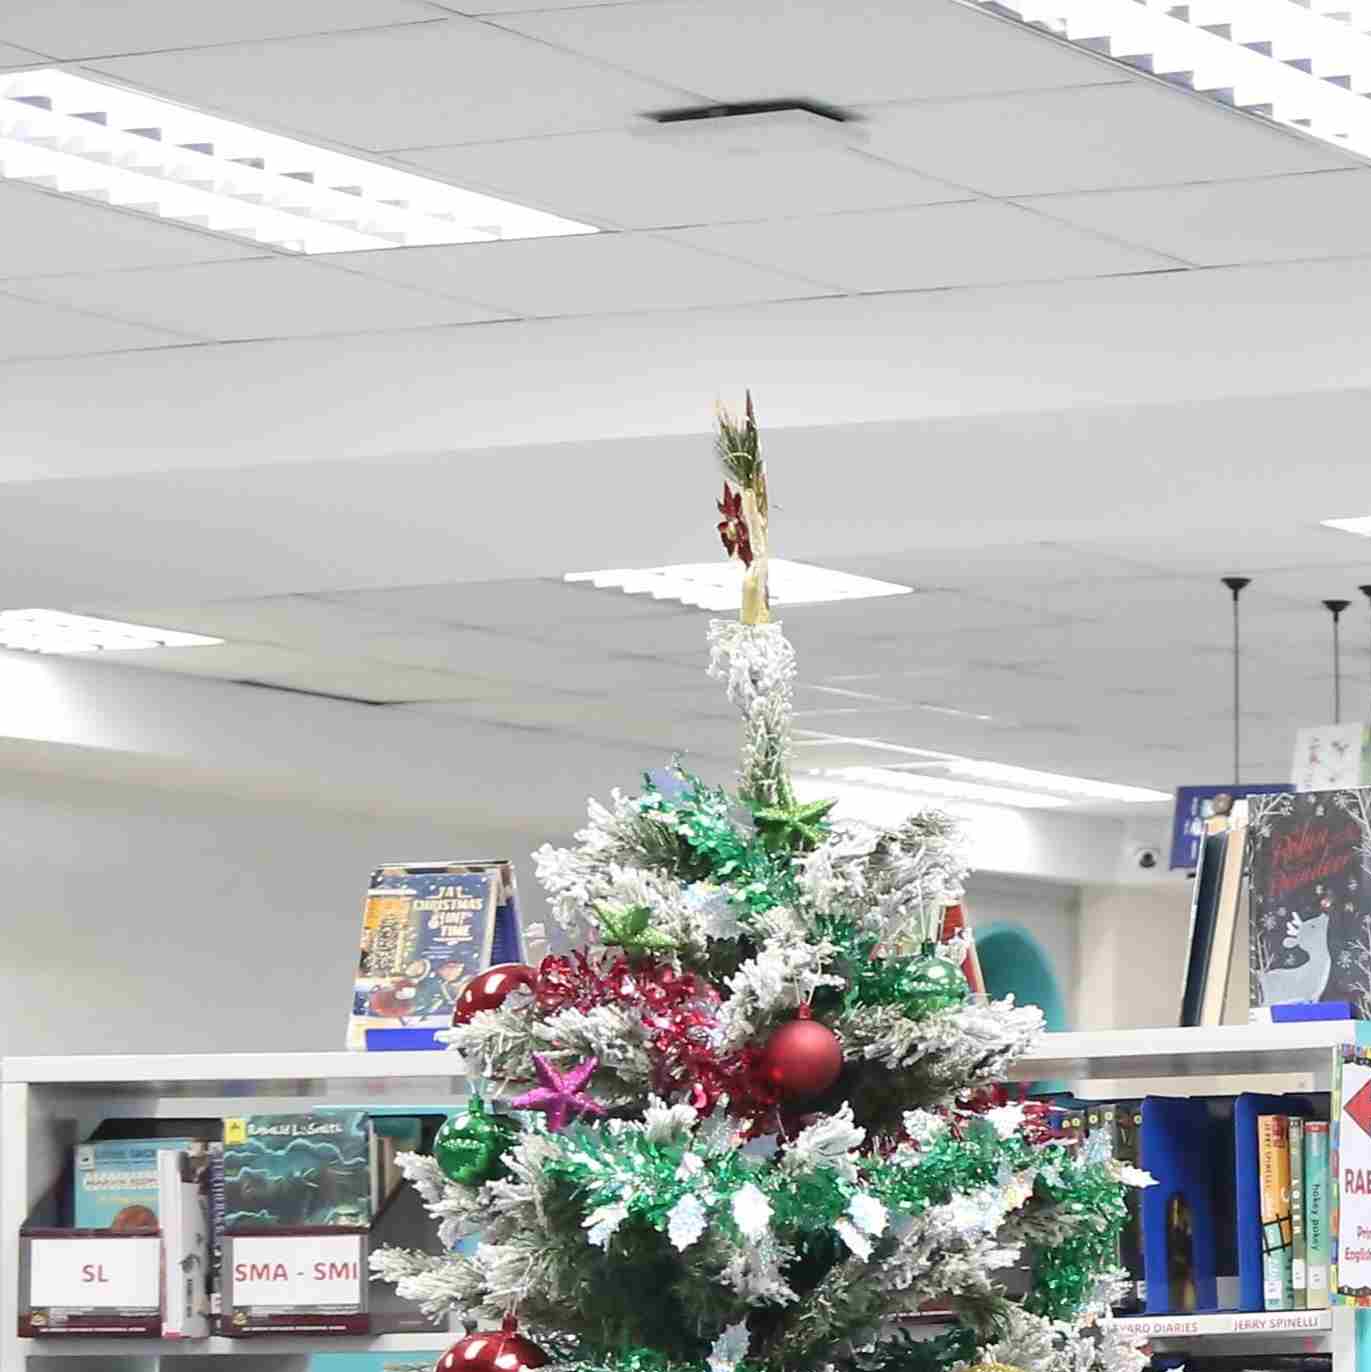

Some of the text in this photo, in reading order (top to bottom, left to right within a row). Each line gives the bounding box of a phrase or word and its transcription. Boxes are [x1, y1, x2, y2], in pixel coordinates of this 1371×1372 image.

[80, 1264, 110, 1283] SL
[234, 1263, 289, 1283] SMA
[312, 1261, 358, 1281] SMI
[1153, 1321, 1199, 1334] DIARIES
[1234, 1316, 1319, 1331] JERRY SPINELLI
